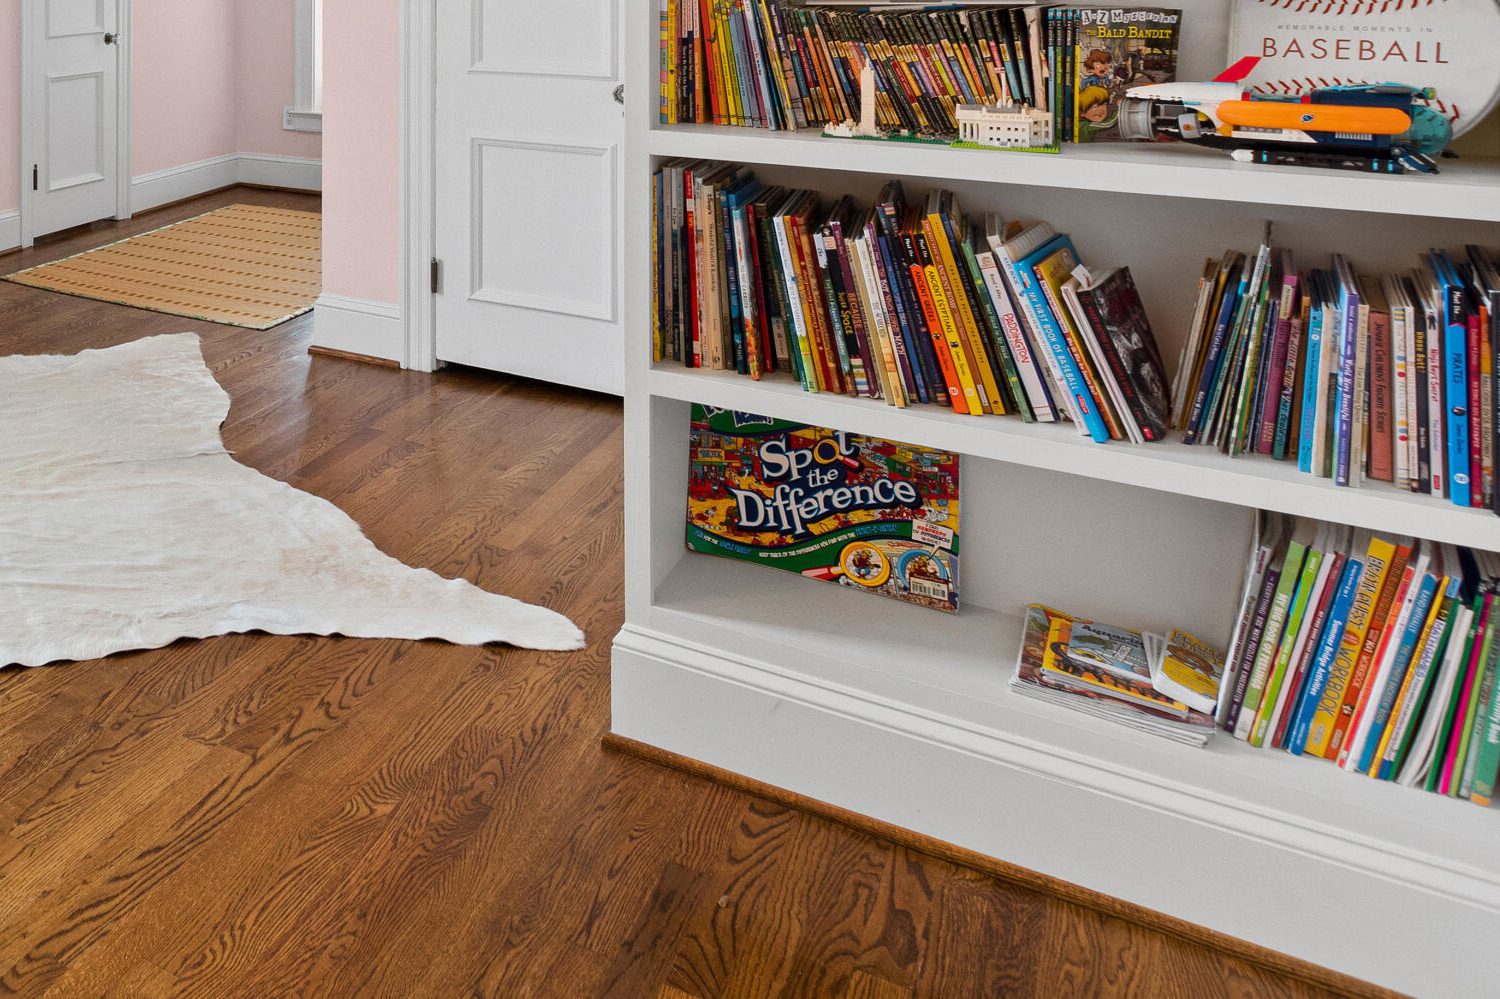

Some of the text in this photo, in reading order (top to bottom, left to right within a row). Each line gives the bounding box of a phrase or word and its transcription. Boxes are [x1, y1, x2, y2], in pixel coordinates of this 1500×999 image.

[1097, 27, 1125, 37] BALD
[1128, 27, 1172, 38] BANDIT
[1262, 37, 1448, 62] BASEBALL
[914, 269, 928, 298] ANCIENT
[923, 299, 936, 322] GREEKS
[927, 269, 942, 297] ANCIENT
[936, 298, 954, 333] EGYPTIANS
[936, 263, 955, 308] ANCIENT ROME
[988, 272, 1002, 299] Bond Alley
[847, 291, 862, 328] BECAUSE
[879, 278, 889, 292] BOY
[893, 334, 905, 355] MATH
[984, 303, 1009, 359] Your Hand Hand
[1003, 312, 1030, 365] PADDINGTON
[1027, 290, 1038, 303] MY
[1033, 303, 1047, 323] FIRST
[1042, 322, 1056, 342] BOOK
[1052, 343, 1062, 354] OF
[1057, 354, 1079, 390] BASEBALL
[1452, 291, 1462, 383] Meet PIRATES
[1278, 327, 1300, 434] The Little Could
[1344, 359, 1352, 375] World
[1374, 322, 1385, 432] JAPANESE CHILDREN'S FAVORITE STORIES
[1428, 348, 1438, 401] Ninja Boy's Secret
[1342, 394, 1351, 420] Beautiful
[759, 430, 854, 480] Spot
[808, 468, 838, 488] the
[734, 476, 916, 535] Difference
[1415, 588, 1429, 607] RAND
[1233, 581, 1275, 702] EVERYTHING MATH PUZZLES FOR KINDERGARTEN
[1250, 592, 1288, 689] MY BIG BOOK OF FEELINGS
[1317, 555, 1384, 718] BRAIN QUEST WORKBOOK
[1318, 645, 1332, 666] Bridge
[1326, 619, 1341, 645] Summer
[1415, 620, 1445, 678] MATH GAMES
[1309, 666, 1325, 696] Activities
[1352, 654, 1369, 688] WORKBOOK
[1390, 655, 1405, 680] ULTIMATE
[1375, 708, 1387, 724] BOOK
[1486, 723, 1498, 743] Book
